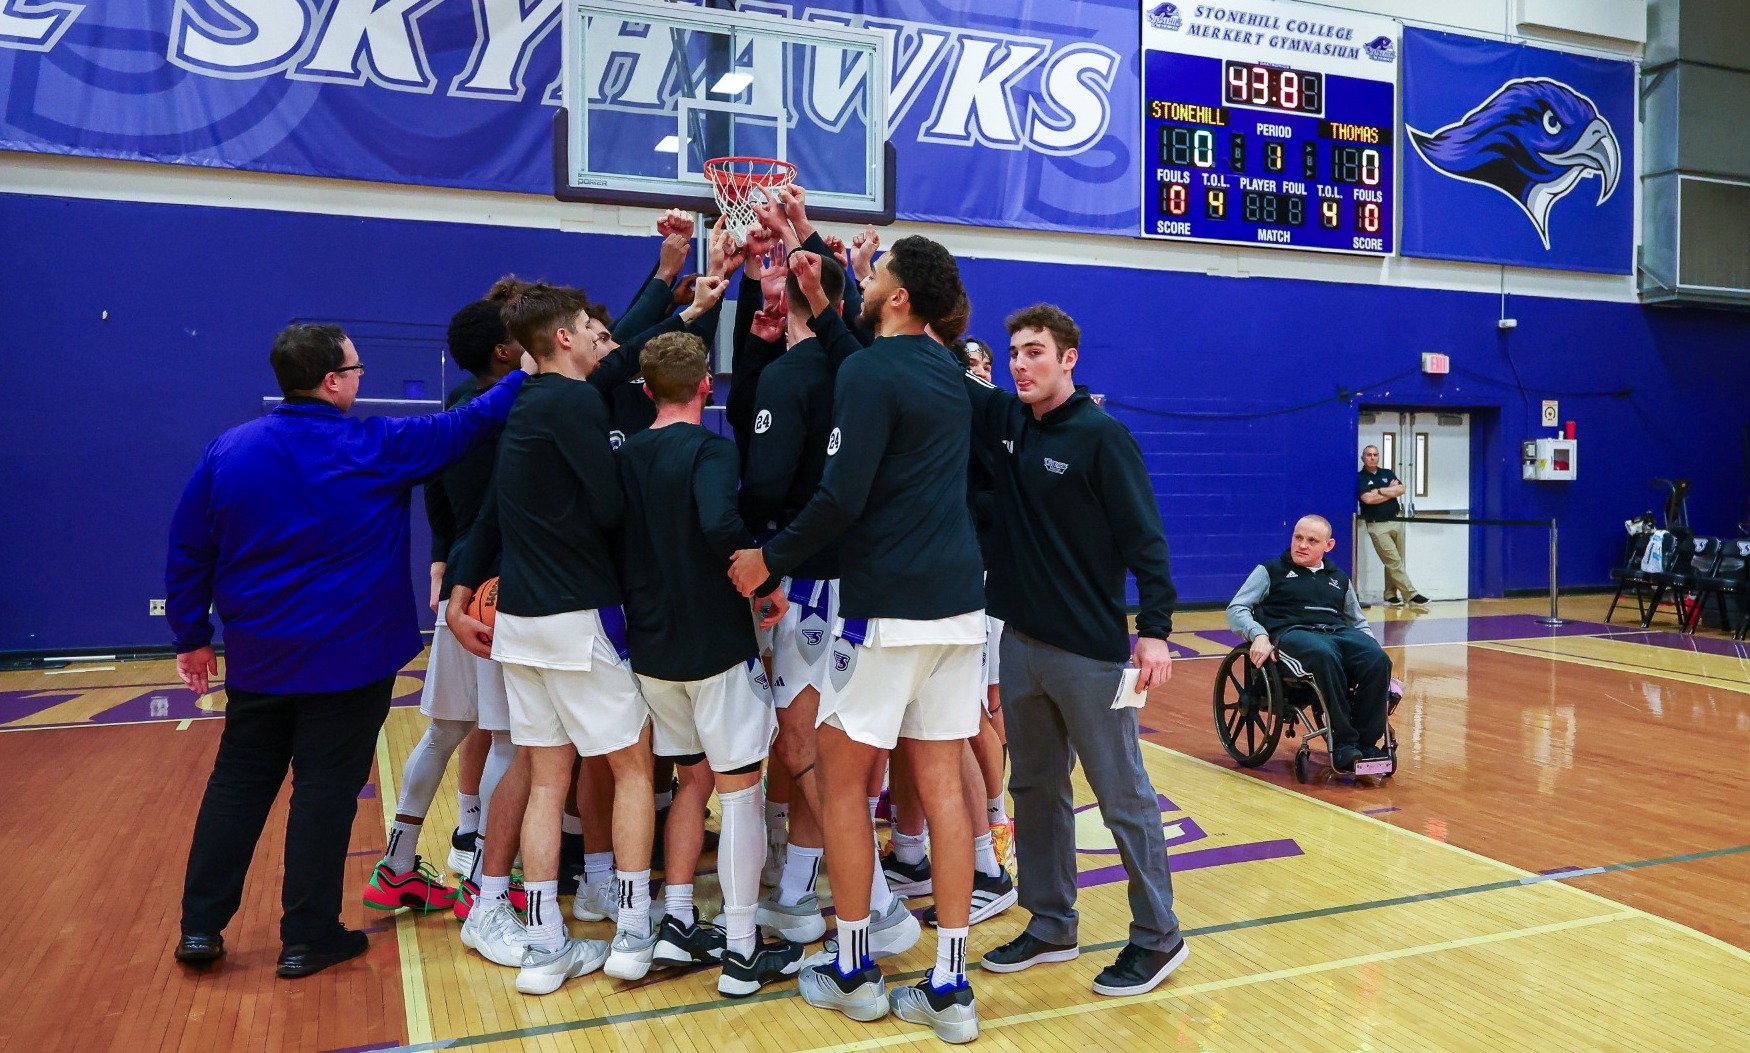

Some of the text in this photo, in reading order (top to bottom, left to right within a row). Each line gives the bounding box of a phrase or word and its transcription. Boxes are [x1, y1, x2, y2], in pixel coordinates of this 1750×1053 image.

[1194, 5, 1281, 31] STONEHILL
[1286, 18, 1355, 41] COLLEGE
[1187, 24, 1266, 47] MERKERT
[1268, 35, 1360, 60] GYMNASIUM
[168, 0, 1121, 157] SKYHAWKS
[1152, 101, 1225, 126] STONEHILL
[1257, 123, 1292, 139] PERIOD
[1331, 123, 1379, 144] THOMAS
[1157, 169, 1190, 184] FOULS
[1202, 173, 1230, 188] T.O.L.
[1240, 177, 1308, 196] PLAYER FOUL
[1317, 185, 1343, 199] T.O.L.
[1353, 188, 1383, 203] FOULS
[1157, 221, 1191, 236] SCORE
[1257, 229, 1291, 243] MATCH
[1353, 237, 1383, 250] SCORE
[1430, 356, 1447, 371] EXIT
[756, 413, 770, 430] 24
[828, 432, 840, 449] 24
